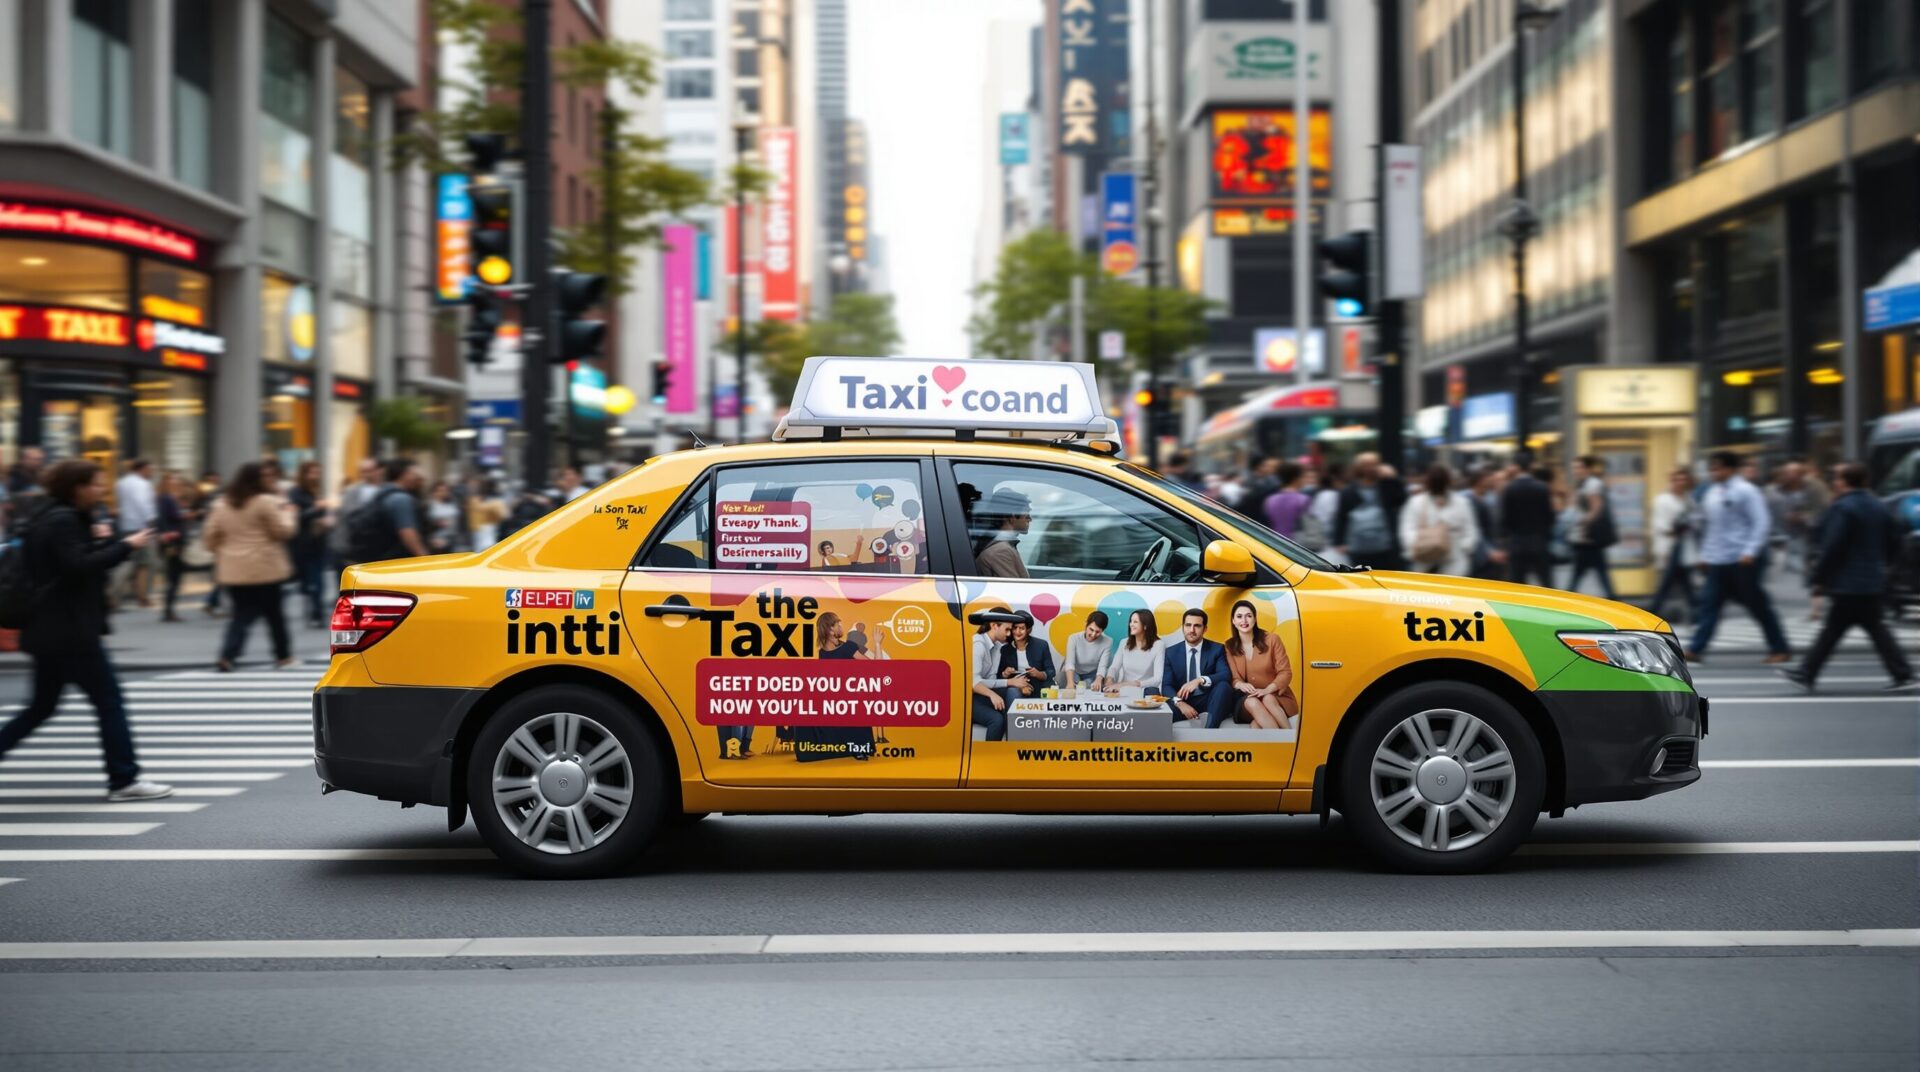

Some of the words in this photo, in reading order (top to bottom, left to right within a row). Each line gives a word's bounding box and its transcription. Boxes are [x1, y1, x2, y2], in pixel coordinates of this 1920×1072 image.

[839, 374, 928, 411] Taxi
[961, 383, 1068, 414] coand
[525, 591, 573, 606] ELPET
[757, 587, 819, 620] the
[507, 609, 620, 655] intti
[699, 610, 815, 657] Taxi
[1404, 610, 1486, 642] taxi
[709, 676, 752, 692] GEET
[757, 677, 803, 692] DOED
[807, 677, 841, 693] YOU
[709, 699, 753, 714] NOW
[823, 700, 858, 715] NOT
[863, 700, 899, 716] YOU
[903, 701, 939, 717] YOU
[1071, 717, 1093, 729] Phe
